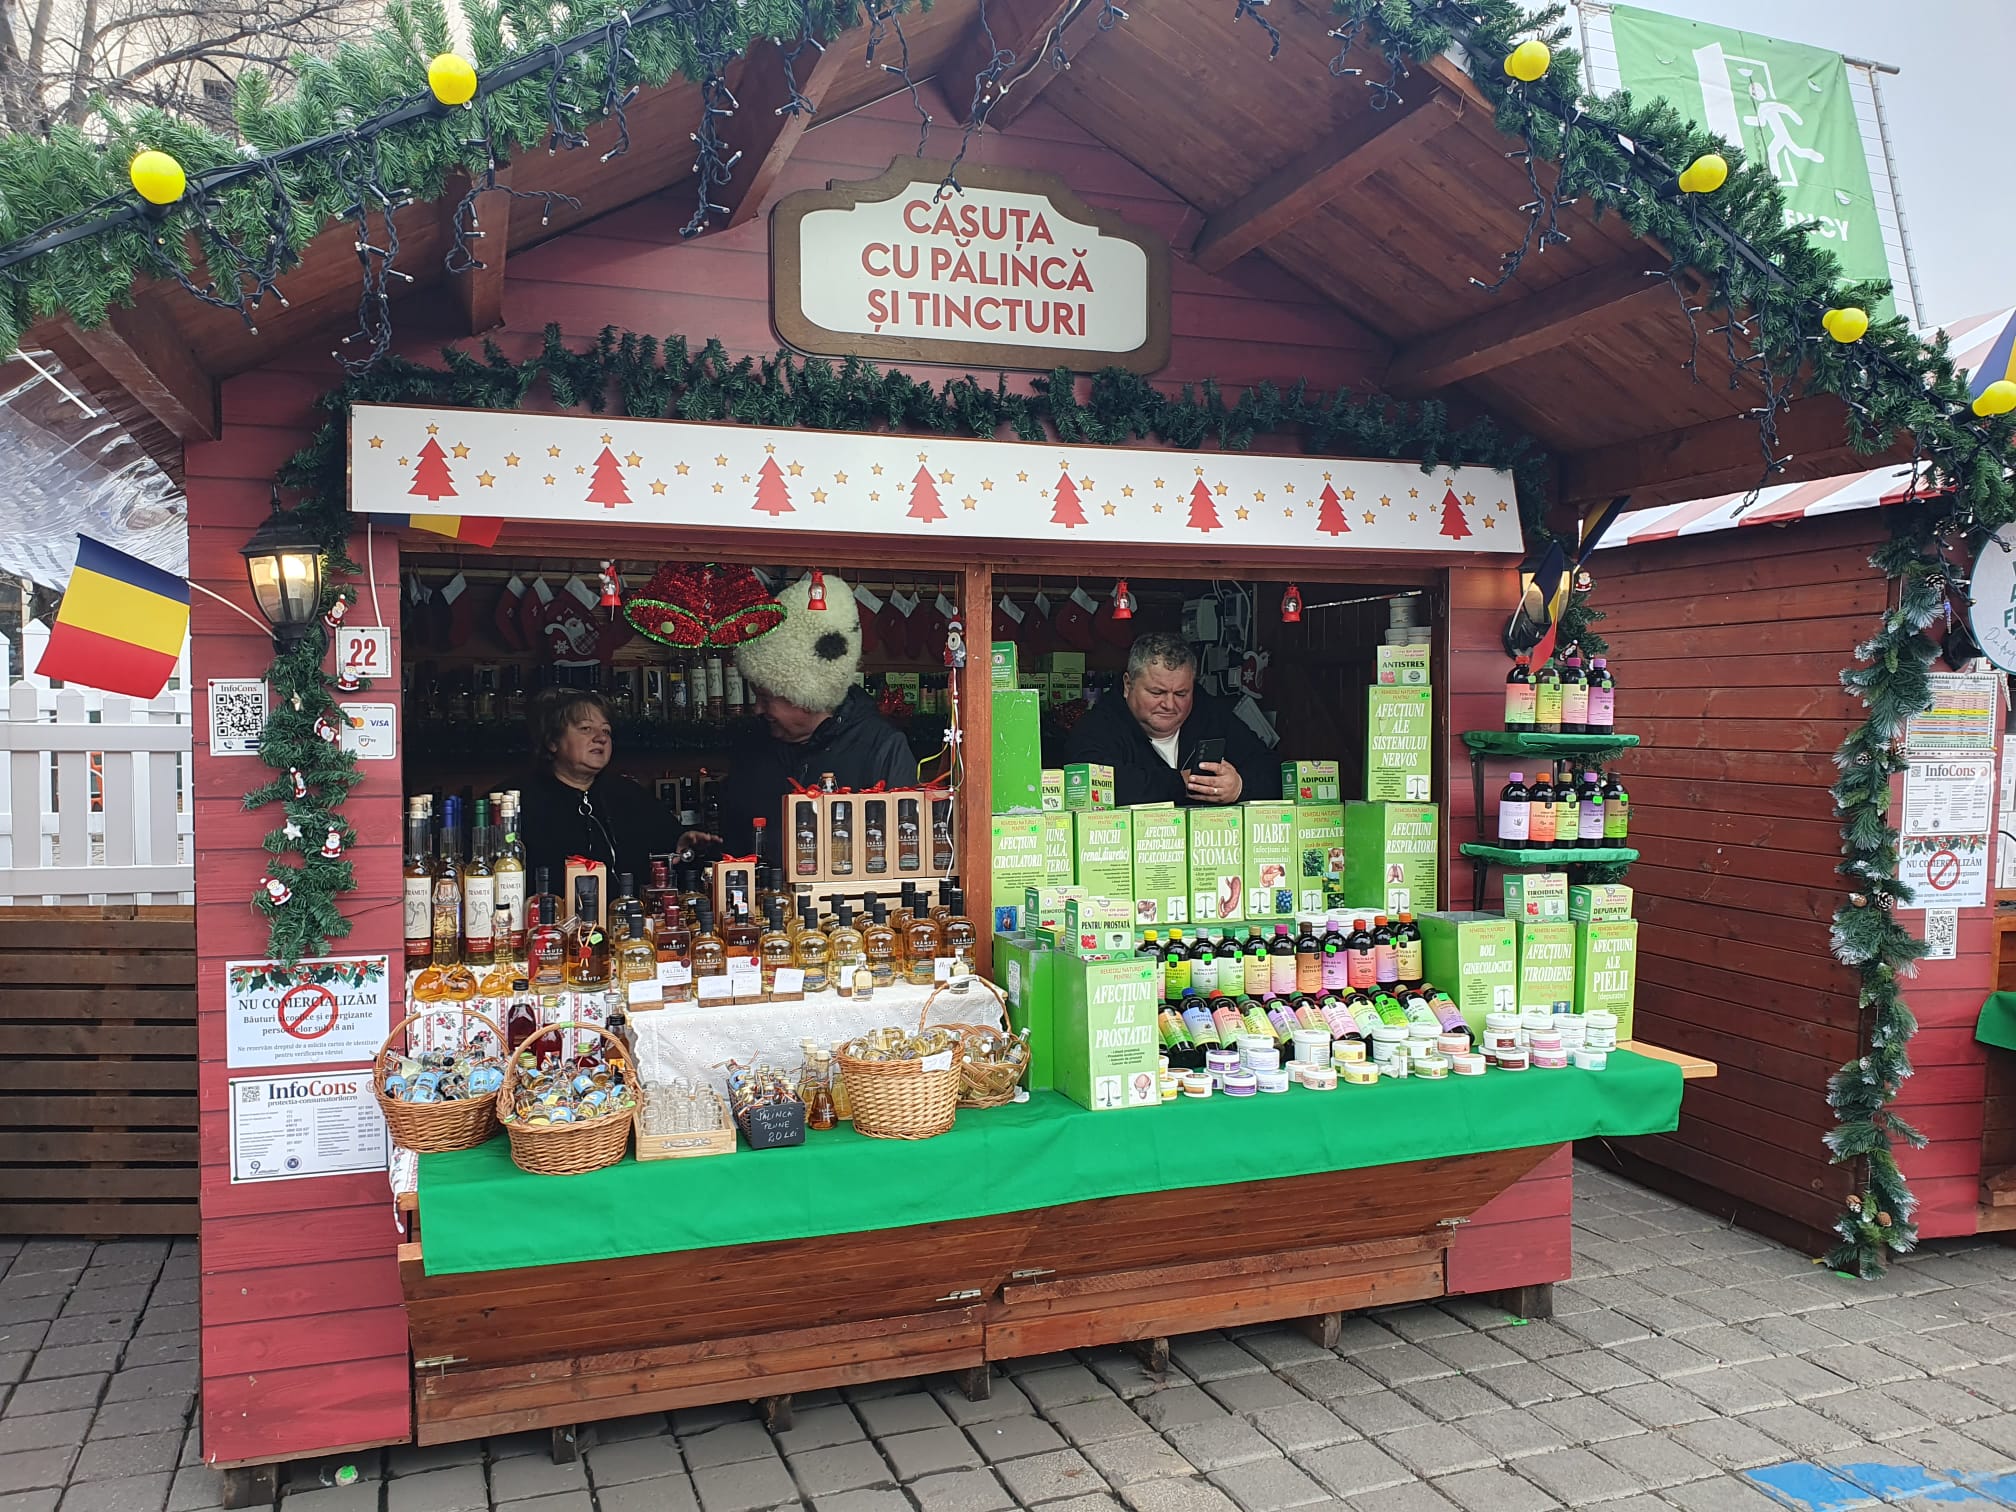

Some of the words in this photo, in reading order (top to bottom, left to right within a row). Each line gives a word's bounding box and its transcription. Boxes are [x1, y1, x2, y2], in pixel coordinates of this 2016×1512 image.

[903, 191, 1054, 251] CĂSUȚA
[861, 242, 919, 279] CU
[931, 238, 1094, 292] PĂLINCĂ
[867, 289, 898, 332] ȘI
[908, 291, 1086, 336] TINCTURI
[345, 638, 377, 667] 22
[1382, 660, 1425, 668] ANTISTRES
[220, 684, 257, 693] InfoCons
[370, 719, 389, 727] VISA
[1392, 720, 1410, 734] ALE
[1372, 736, 1428, 750] SISTEMULUI
[1381, 752, 1418, 768] NERVOS
[1925, 763, 1976, 777] InfoCons
[1091, 778, 1113, 788] RENOFIT
[1300, 776, 1334, 784] ADIPOLIT
[1089, 829, 1121, 845] RINICHI
[1193, 829, 1220, 847] BOLI
[1223, 829, 1240, 847] DE
[1253, 823, 1291, 844] DIABET
[1298, 827, 1344, 839] OBEZITATE
[1385, 839, 1437, 854] RESPIRATORII
[1192, 847, 1241, 866] STOMAC
[1593, 907, 1628, 915] DEPURATIV
[1081, 921, 1102, 930] PENTRU
[1103, 920, 1131, 929] PROSTATĂ
[1479, 944, 1496, 957] BOLI
[1526, 943, 1572, 964] AFECȚIUNI
[1592, 938, 1633, 955] AFECȚIUNI
[1463, 960, 1513, 975] GINECOLOGICE
[1605, 955, 1621, 969] ALE
[1524, 966, 1573, 982] TIROIDIENE
[1593, 970, 1629, 993] PIELII
[1092, 981, 1153, 1005] AFECȚIUNI
[238, 998, 258, 1011] NU
[262, 992, 378, 1010] COMERCIALIZĂM
[243, 1015, 276, 1024] Băuturi
[1113, 1004, 1135, 1025] ALE
[341, 1023, 355, 1031] ani
[1095, 1024, 1153, 1049] PROSTATEI
[267, 1079, 357, 1100] InfoCons
[768, 1131, 782, 1143] 20
